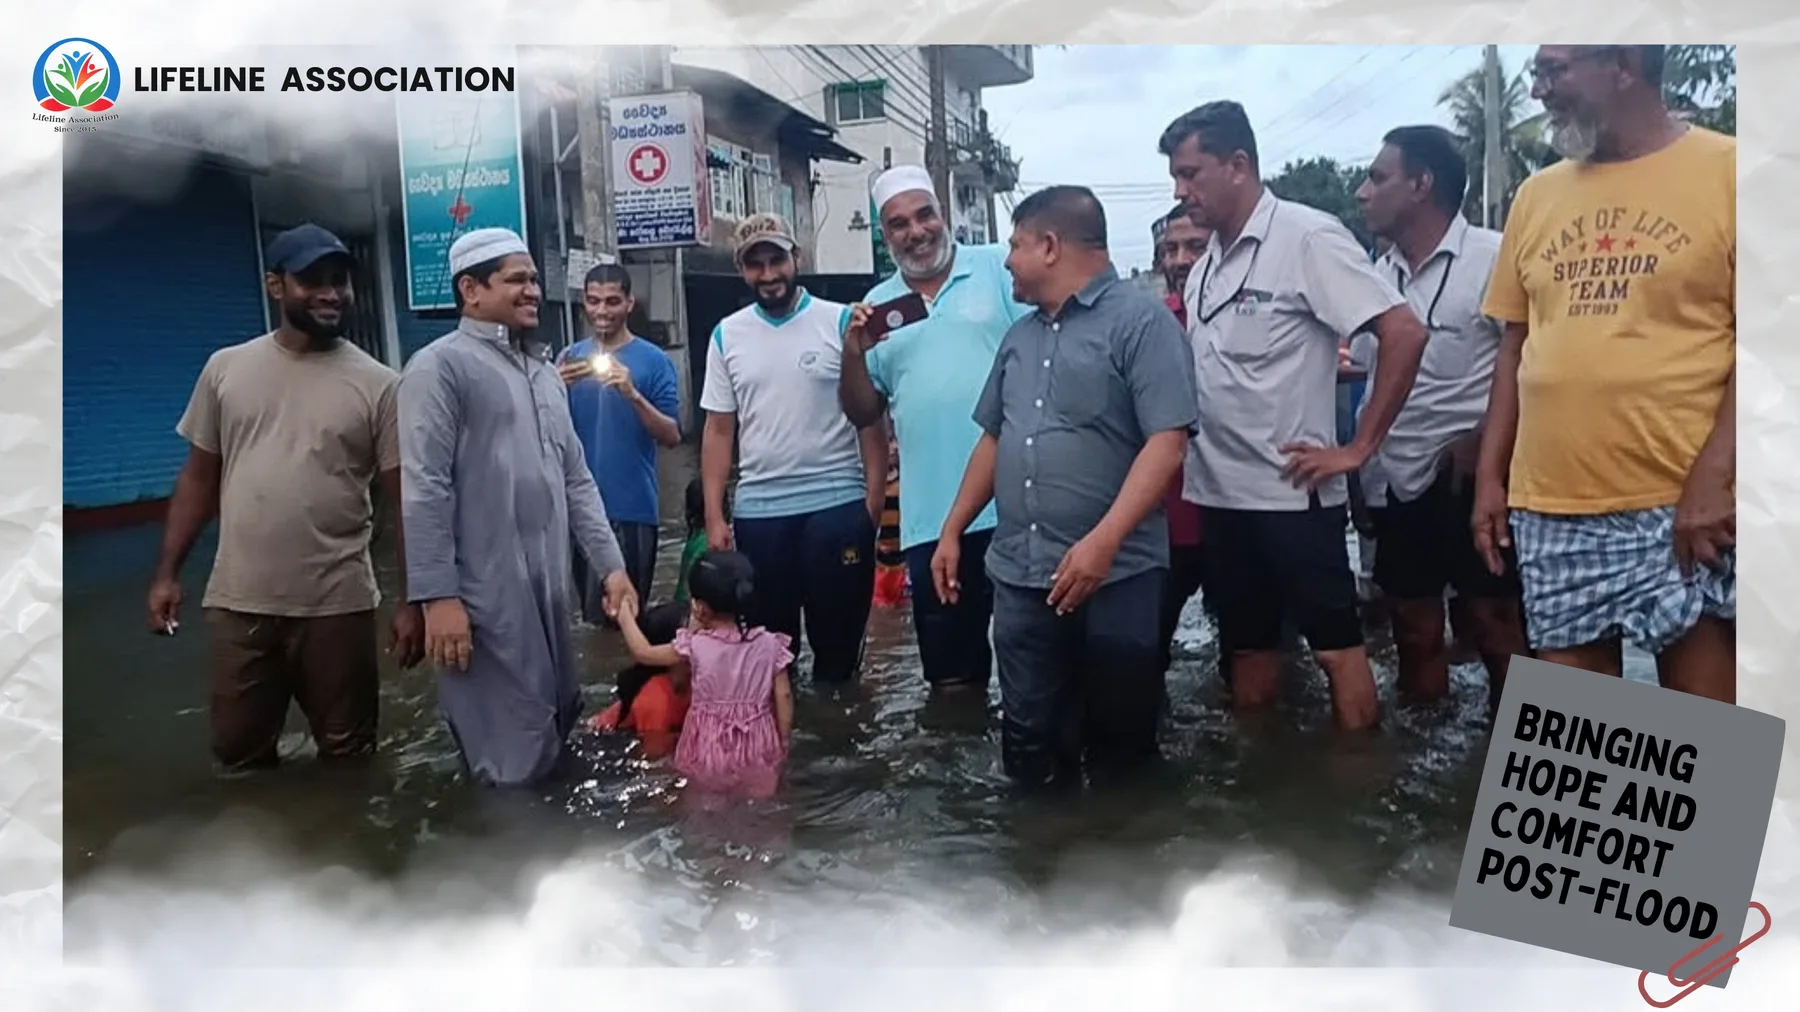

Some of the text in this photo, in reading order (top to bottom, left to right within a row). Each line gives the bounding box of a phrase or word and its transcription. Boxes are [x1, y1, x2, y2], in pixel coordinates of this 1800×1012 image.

[1541, 207, 1692, 262] WAY OF LIFE
[1553, 254, 1659, 282] SUPERIOR
[1569, 279, 1630, 301] TEAM
